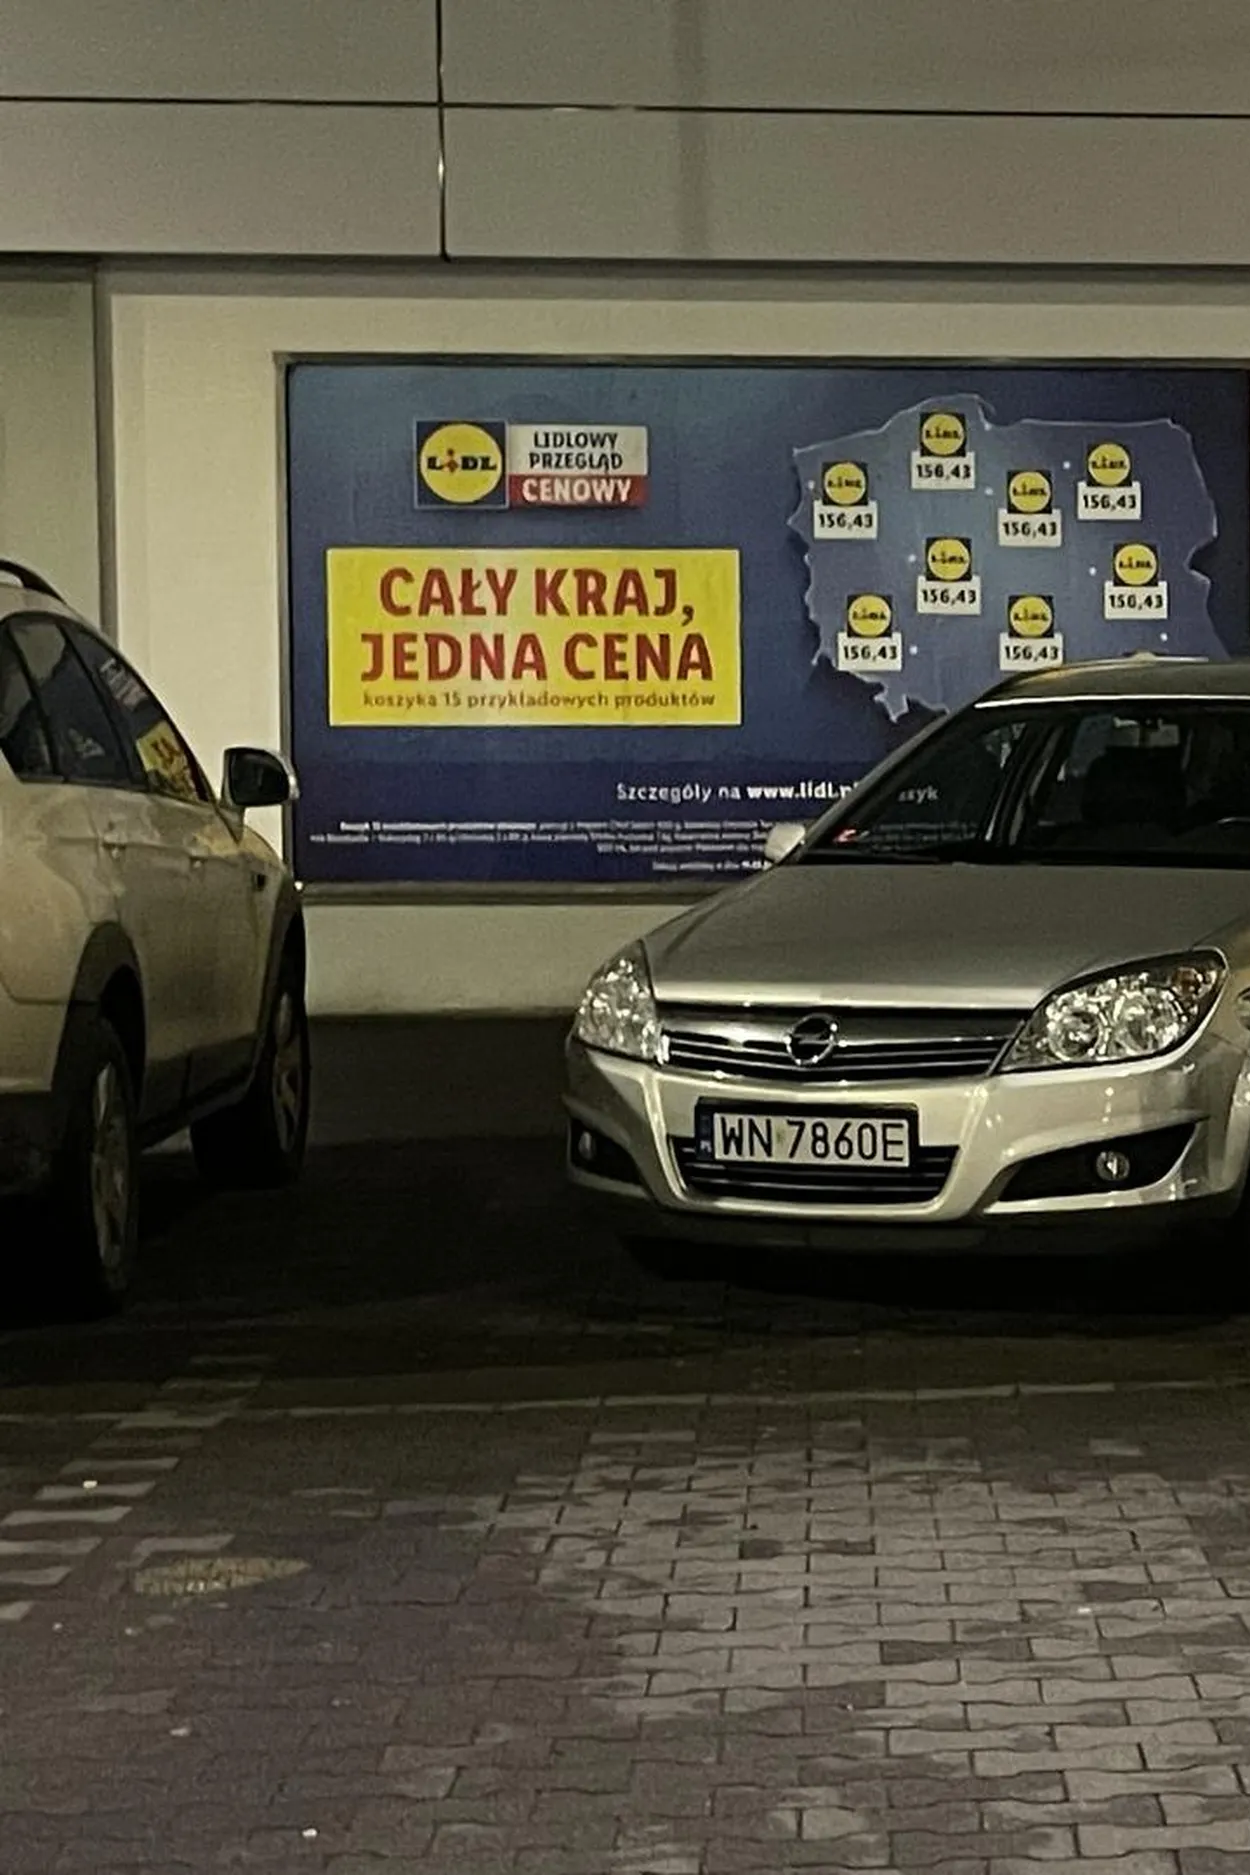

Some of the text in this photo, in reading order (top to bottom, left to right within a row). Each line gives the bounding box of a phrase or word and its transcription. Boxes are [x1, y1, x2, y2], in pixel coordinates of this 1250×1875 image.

[533, 431, 618, 449] LIDLOWY
[529, 452, 624, 474] PRZEGLĄD
[917, 464, 971, 481] 156,43
[521, 477, 632, 502] CENOWY
[1082, 493, 1137, 511] 156,43
[818, 512, 873, 530] 156,43
[1003, 521, 1057, 539] 156,43
[379, 567, 695, 626] CAŁY KRAJ,
[921, 588, 977, 606] 156,43
[1108, 594, 1164, 611] 156,43
[361, 633, 714, 682] JEDNA CENA
[843, 645, 898, 662] 156,43
[1004, 645, 1060, 662] 156,43
[363, 691, 438, 710] koszyka
[443, 691, 462, 707] 15
[614, 691, 716, 709] produktów
[616, 783, 711, 803] Szczegóły
[718, 786, 741, 799] na
[720, 1116, 904, 1162] WN 7860E
